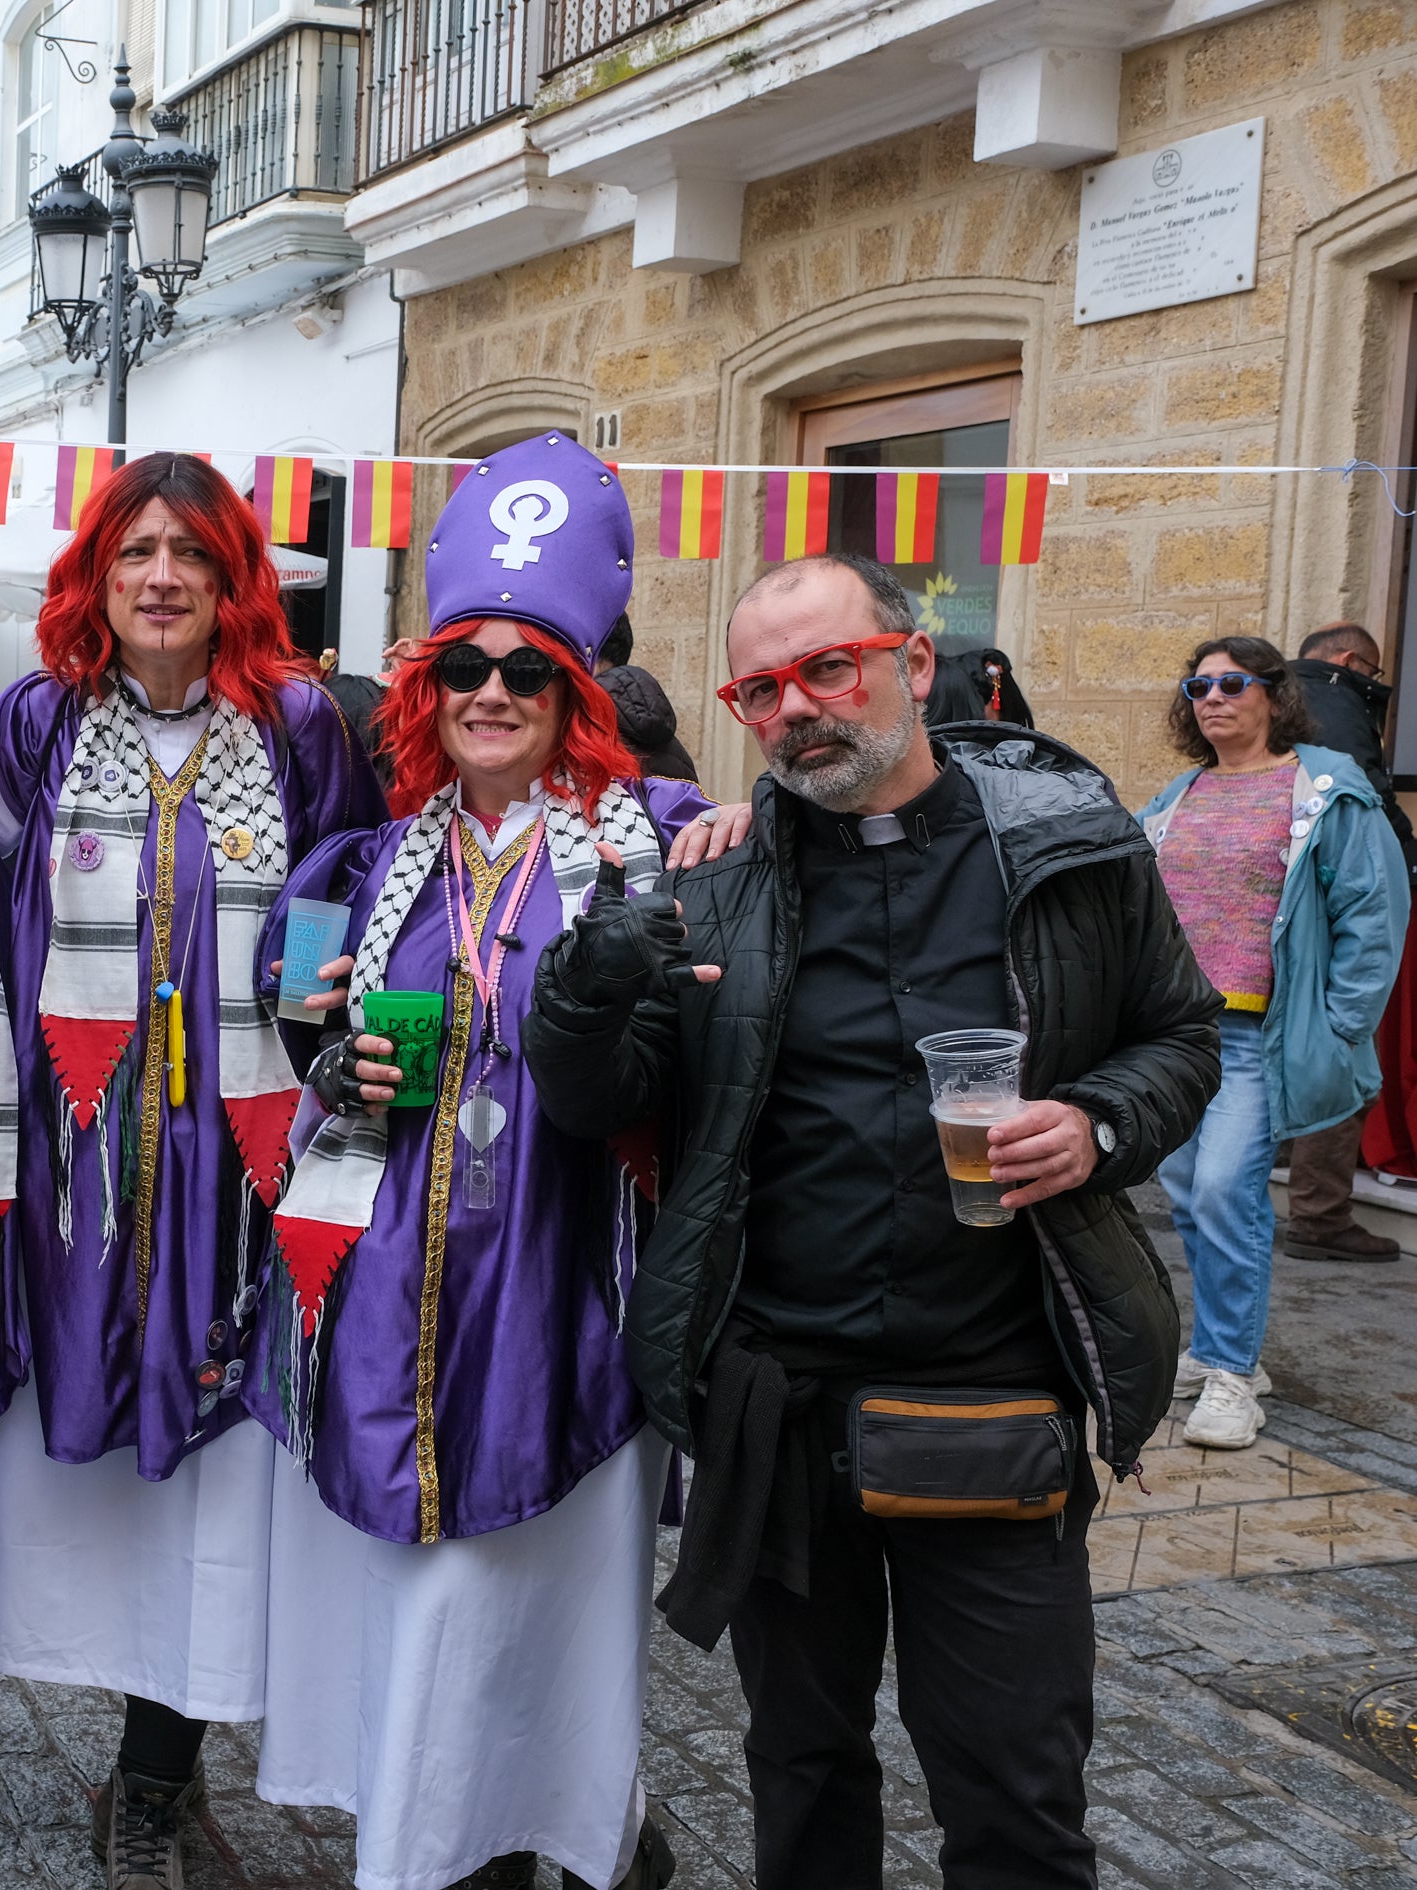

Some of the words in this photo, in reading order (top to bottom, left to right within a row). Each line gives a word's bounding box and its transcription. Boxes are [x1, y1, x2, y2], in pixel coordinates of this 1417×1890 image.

[1101, 213, 1126, 227] Manuel
[1128, 207, 1150, 221] Vargas
[596, 414, 617, 448] 11
[937, 597, 992, 615] VERDES
[947, 618, 992, 635] EQUO
[388, 1017, 409, 1032] DE
